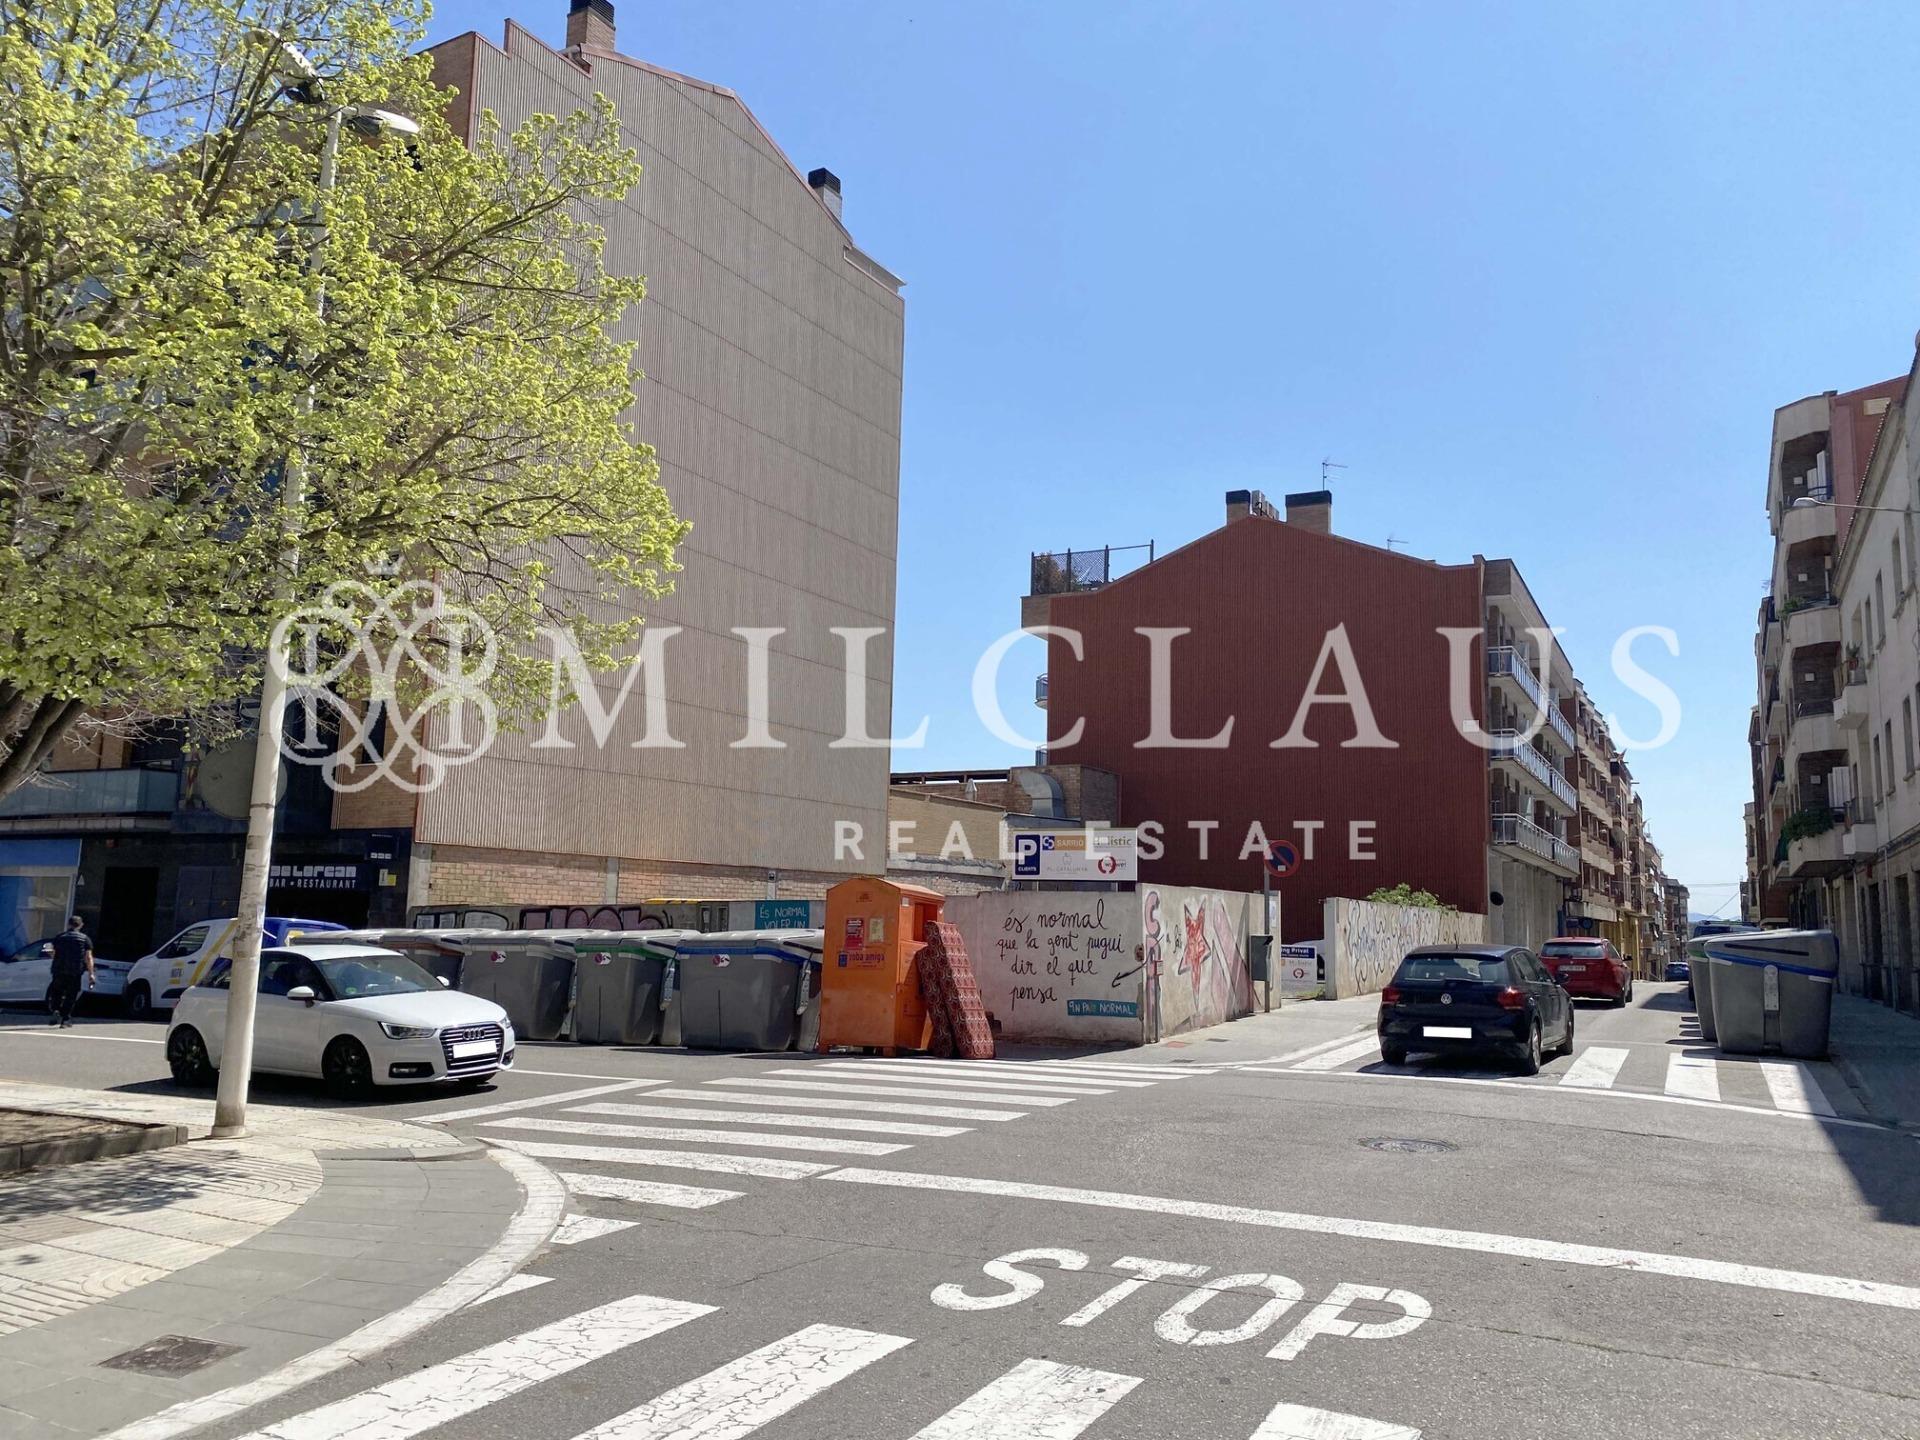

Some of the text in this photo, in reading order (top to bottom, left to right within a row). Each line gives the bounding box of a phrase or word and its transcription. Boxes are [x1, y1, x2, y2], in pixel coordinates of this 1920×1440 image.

[1018, 839, 1037, 865] P
[268, 878, 357, 889] BAR RESTAURANT
[1037, 898, 1108, 930] normal
[996, 928, 1125, 960] que la gent pugui
[1010, 954, 1098, 986] dir el que
[1009, 984, 1058, 1011] pensa
[930, 1247, 1433, 1361] STOP
